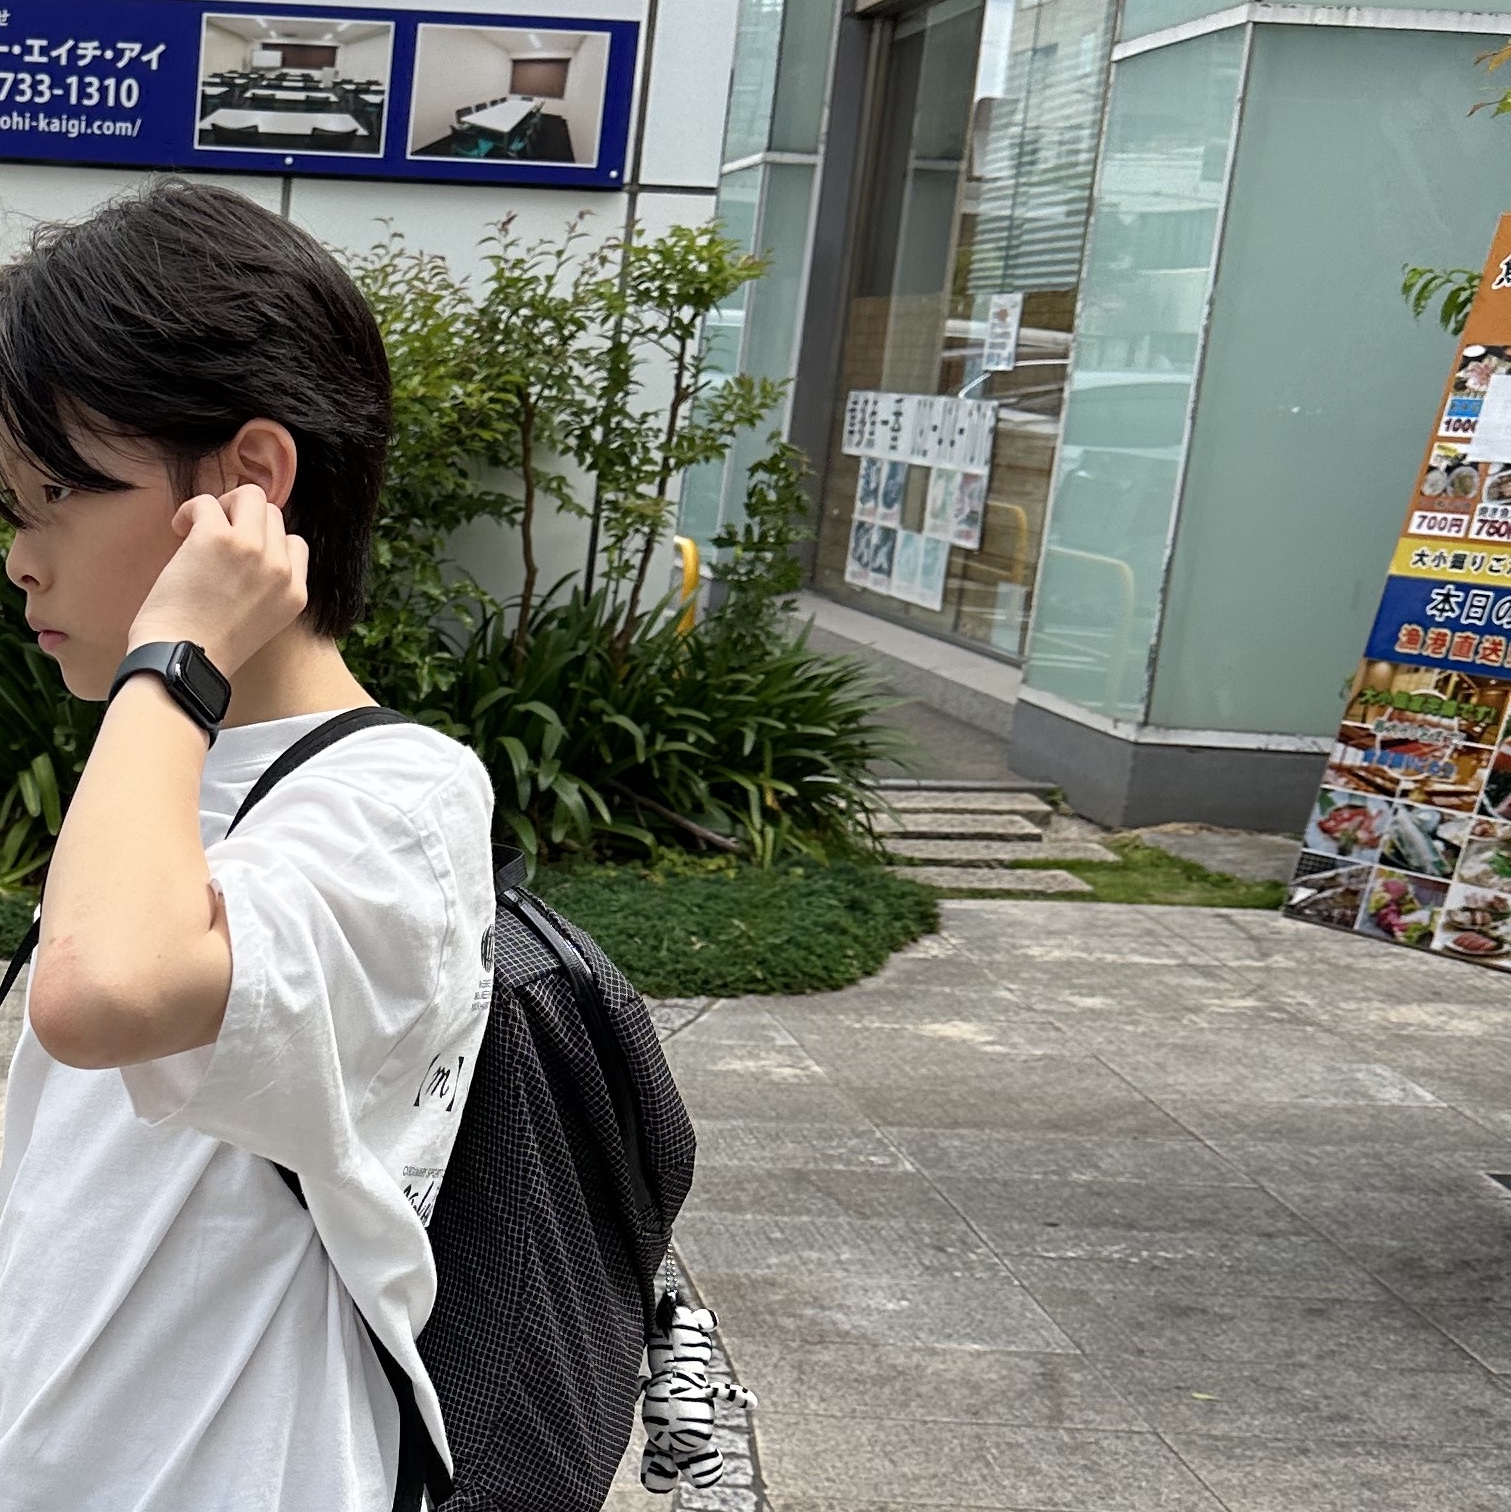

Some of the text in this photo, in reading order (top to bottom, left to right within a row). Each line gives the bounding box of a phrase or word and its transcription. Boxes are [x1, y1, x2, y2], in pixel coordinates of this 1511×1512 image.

[1415, 514, 1465, 534] 700円
[1397, 625, 1511, 666] 漁港直送
